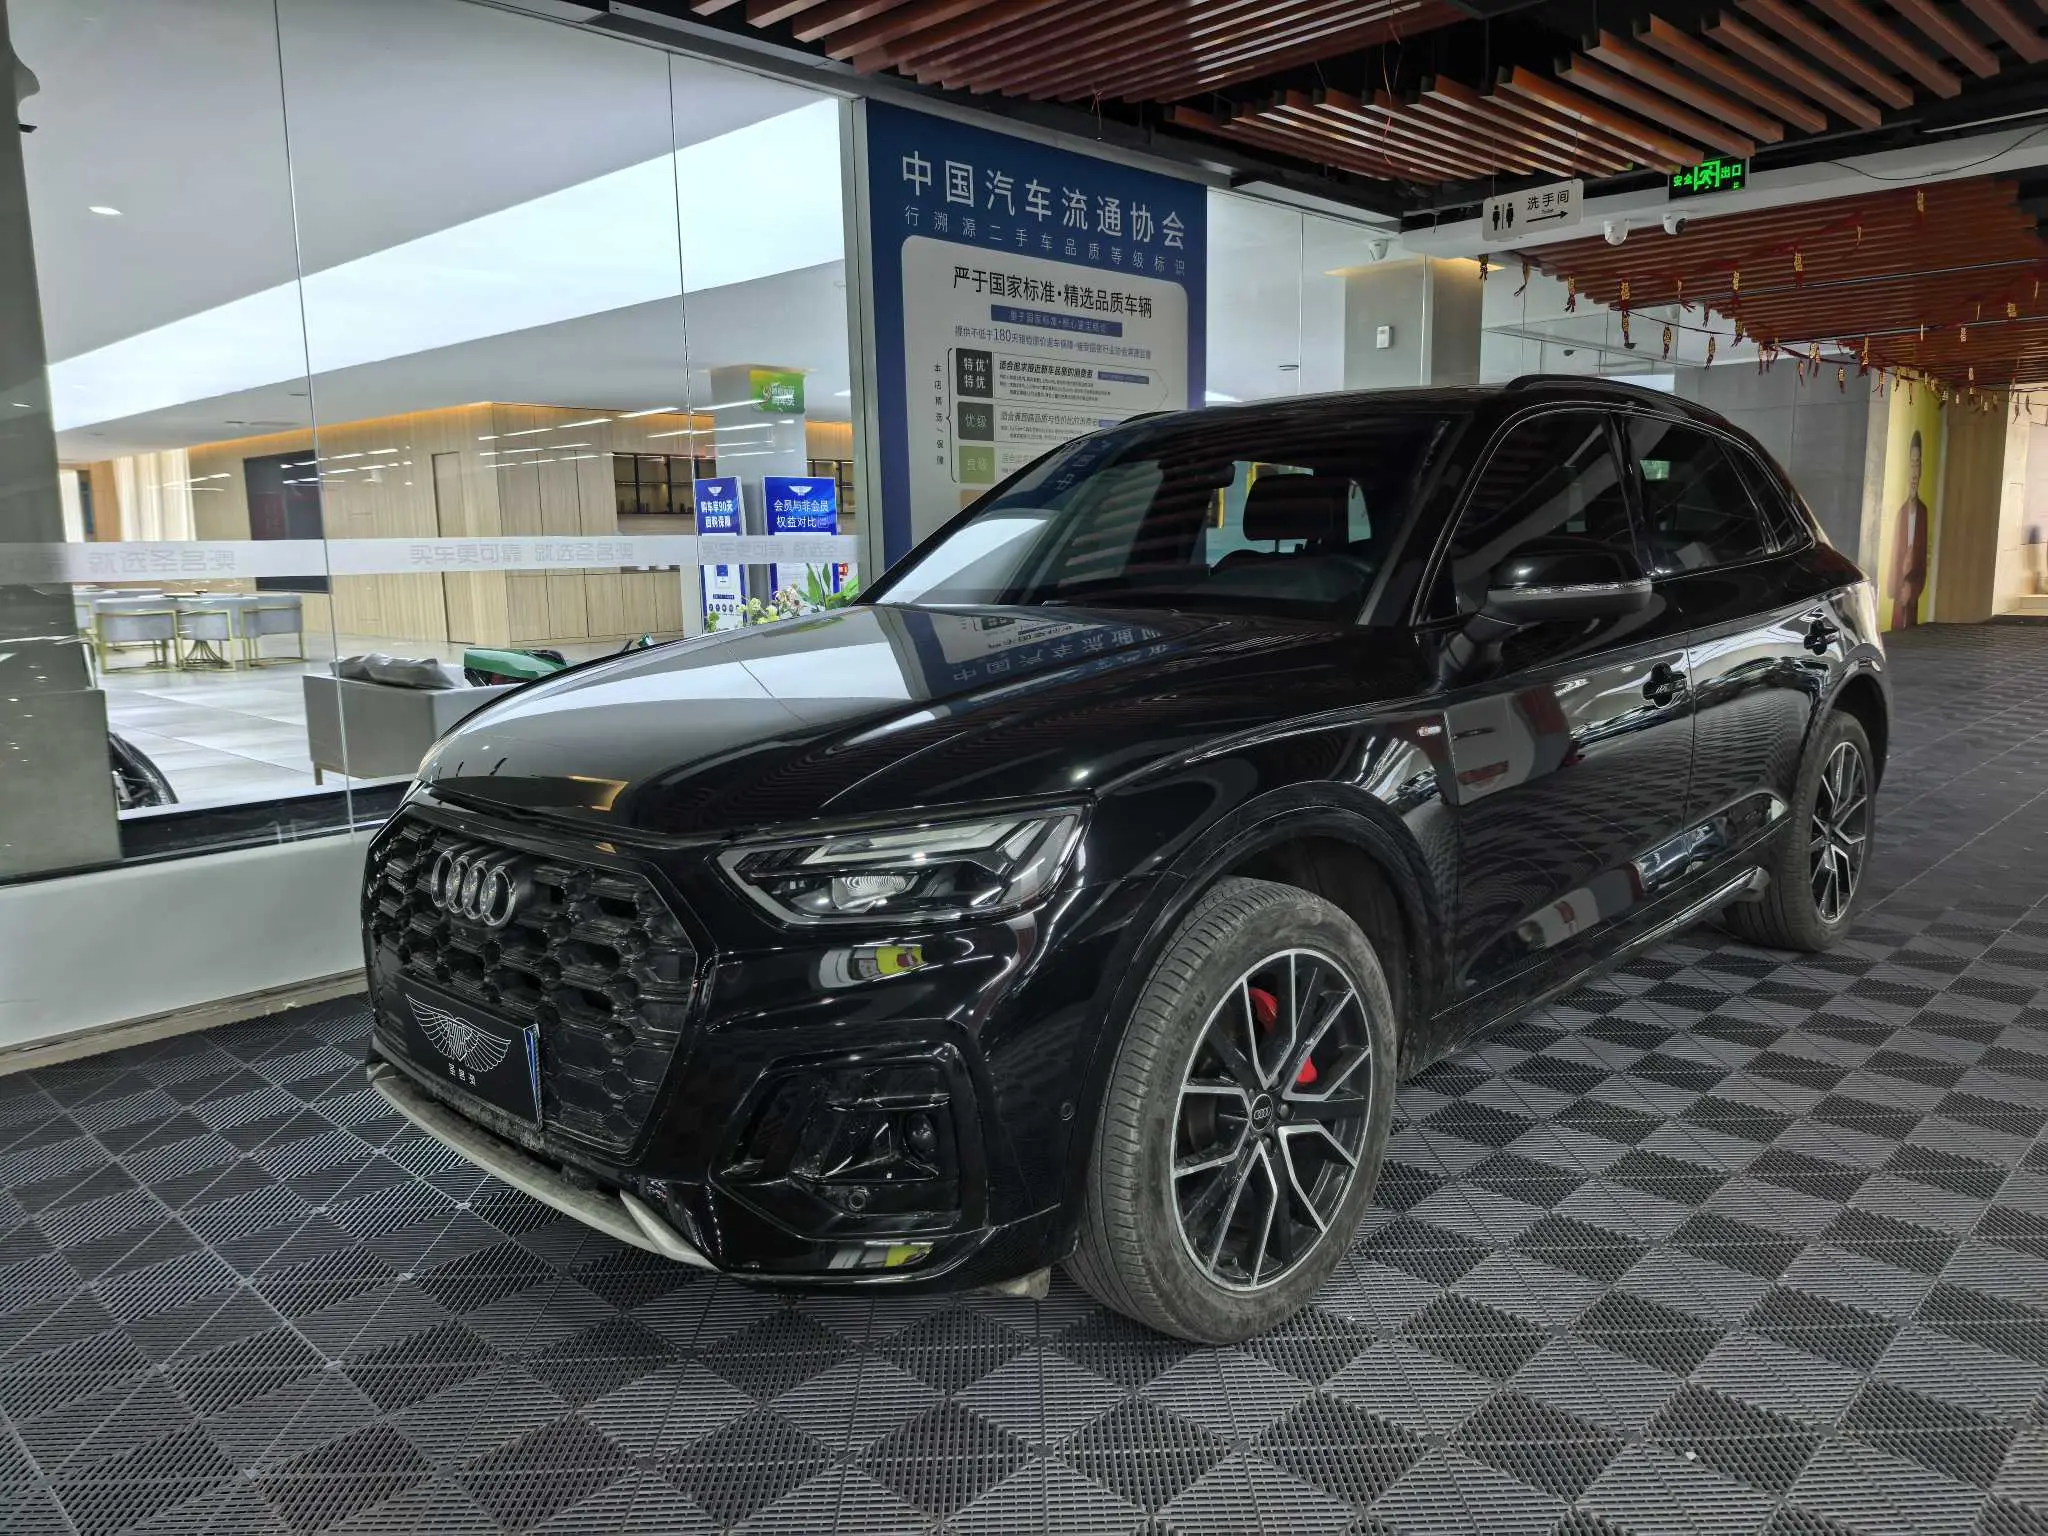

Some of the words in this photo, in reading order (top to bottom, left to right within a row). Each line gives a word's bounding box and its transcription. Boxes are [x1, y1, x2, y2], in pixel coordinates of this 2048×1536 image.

[902, 150, 1185, 250] 中国汽车流通协会
[1527, 190, 1569, 210] 洗手间
[774, 499, 829, 512] 会员与非会员
[776, 515, 817, 528] 权益对比
